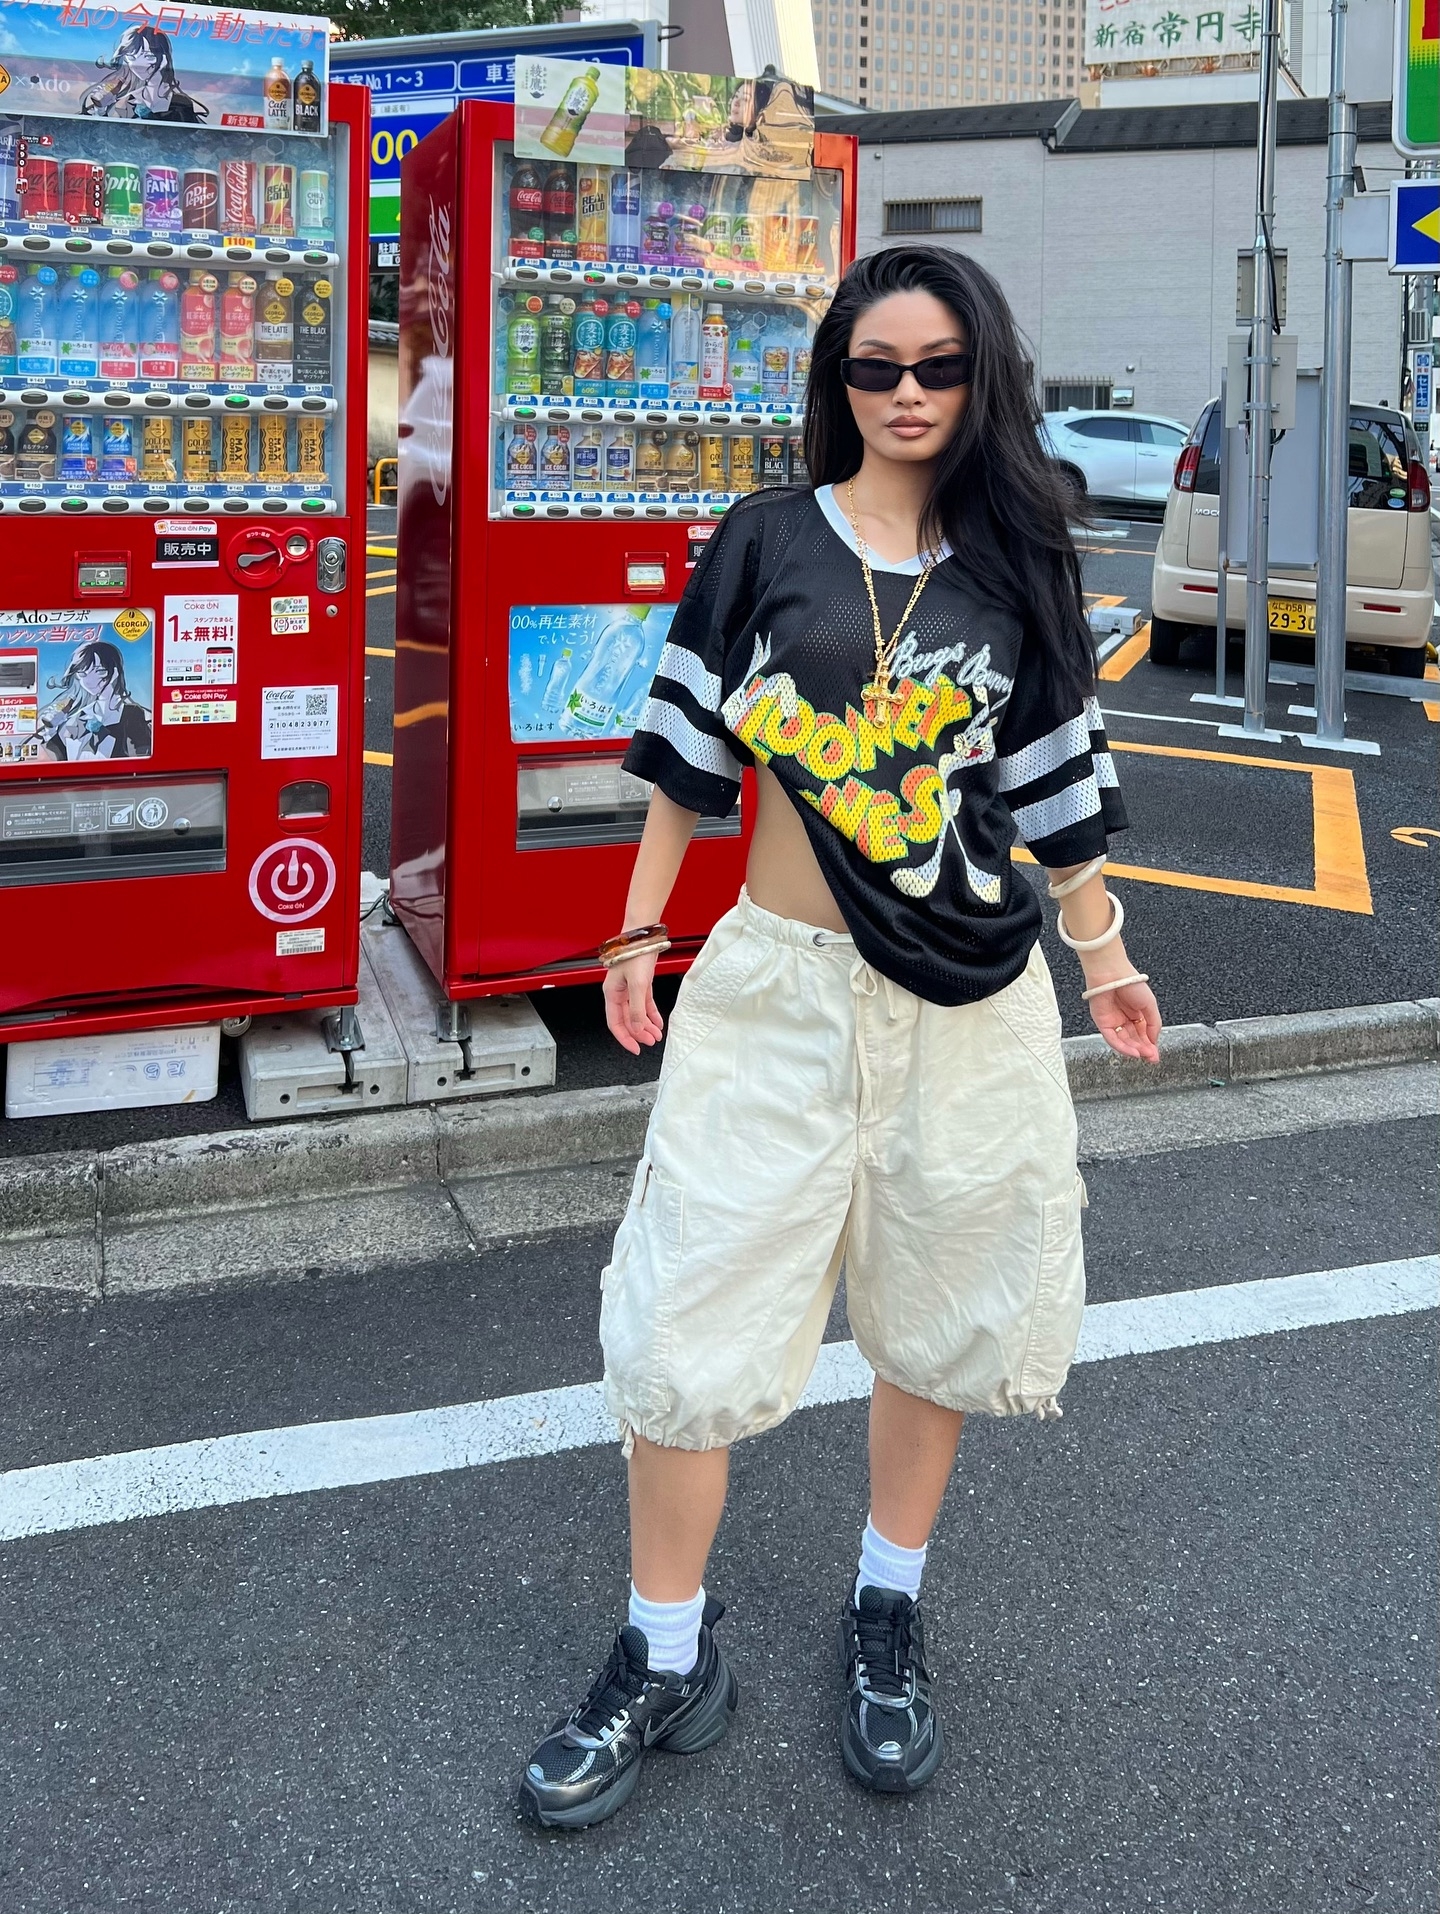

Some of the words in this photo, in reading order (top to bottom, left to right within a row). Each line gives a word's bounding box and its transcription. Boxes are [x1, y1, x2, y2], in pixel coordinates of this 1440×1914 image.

[30, 75, 71, 93] Ado
[268, 108, 287, 117] LATTE
[295, 104, 319, 116] BLACK
[227, 116, 260, 127] 新登場
[193, 186, 208, 197] Dr
[267, 183, 290, 193] REAL
[185, 190, 215, 207] Pepper
[267, 191, 290, 202] GOLD
[307, 191, 325, 200] CHILL
[582, 193, 605, 206] REAL
[309, 198, 323, 206] OUT
[582, 202, 605, 215] GOLD
[227, 237, 253, 246] 110円
[272, 326, 288, 334] LATTE
[300, 326, 310, 334] THE
[311, 326, 326, 335] BLACK
[235, 438, 243, 461] MAX
[274, 438, 282, 461] MAX
[309, 438, 317, 461] MAX
[1194, 508, 1220, 517] MOC
[164, 542, 212, 556] 販売中
[206, 602, 219, 610] ON
[17, 610, 48, 624] Ado
[116, 620, 148, 628] GEORGIA
[168, 615, 234, 642] 1本無料!
[891, 632, 967, 688] Bugs
[214, 692, 228, 701] Pay
[265, 689, 296, 700] Coca-Cola
